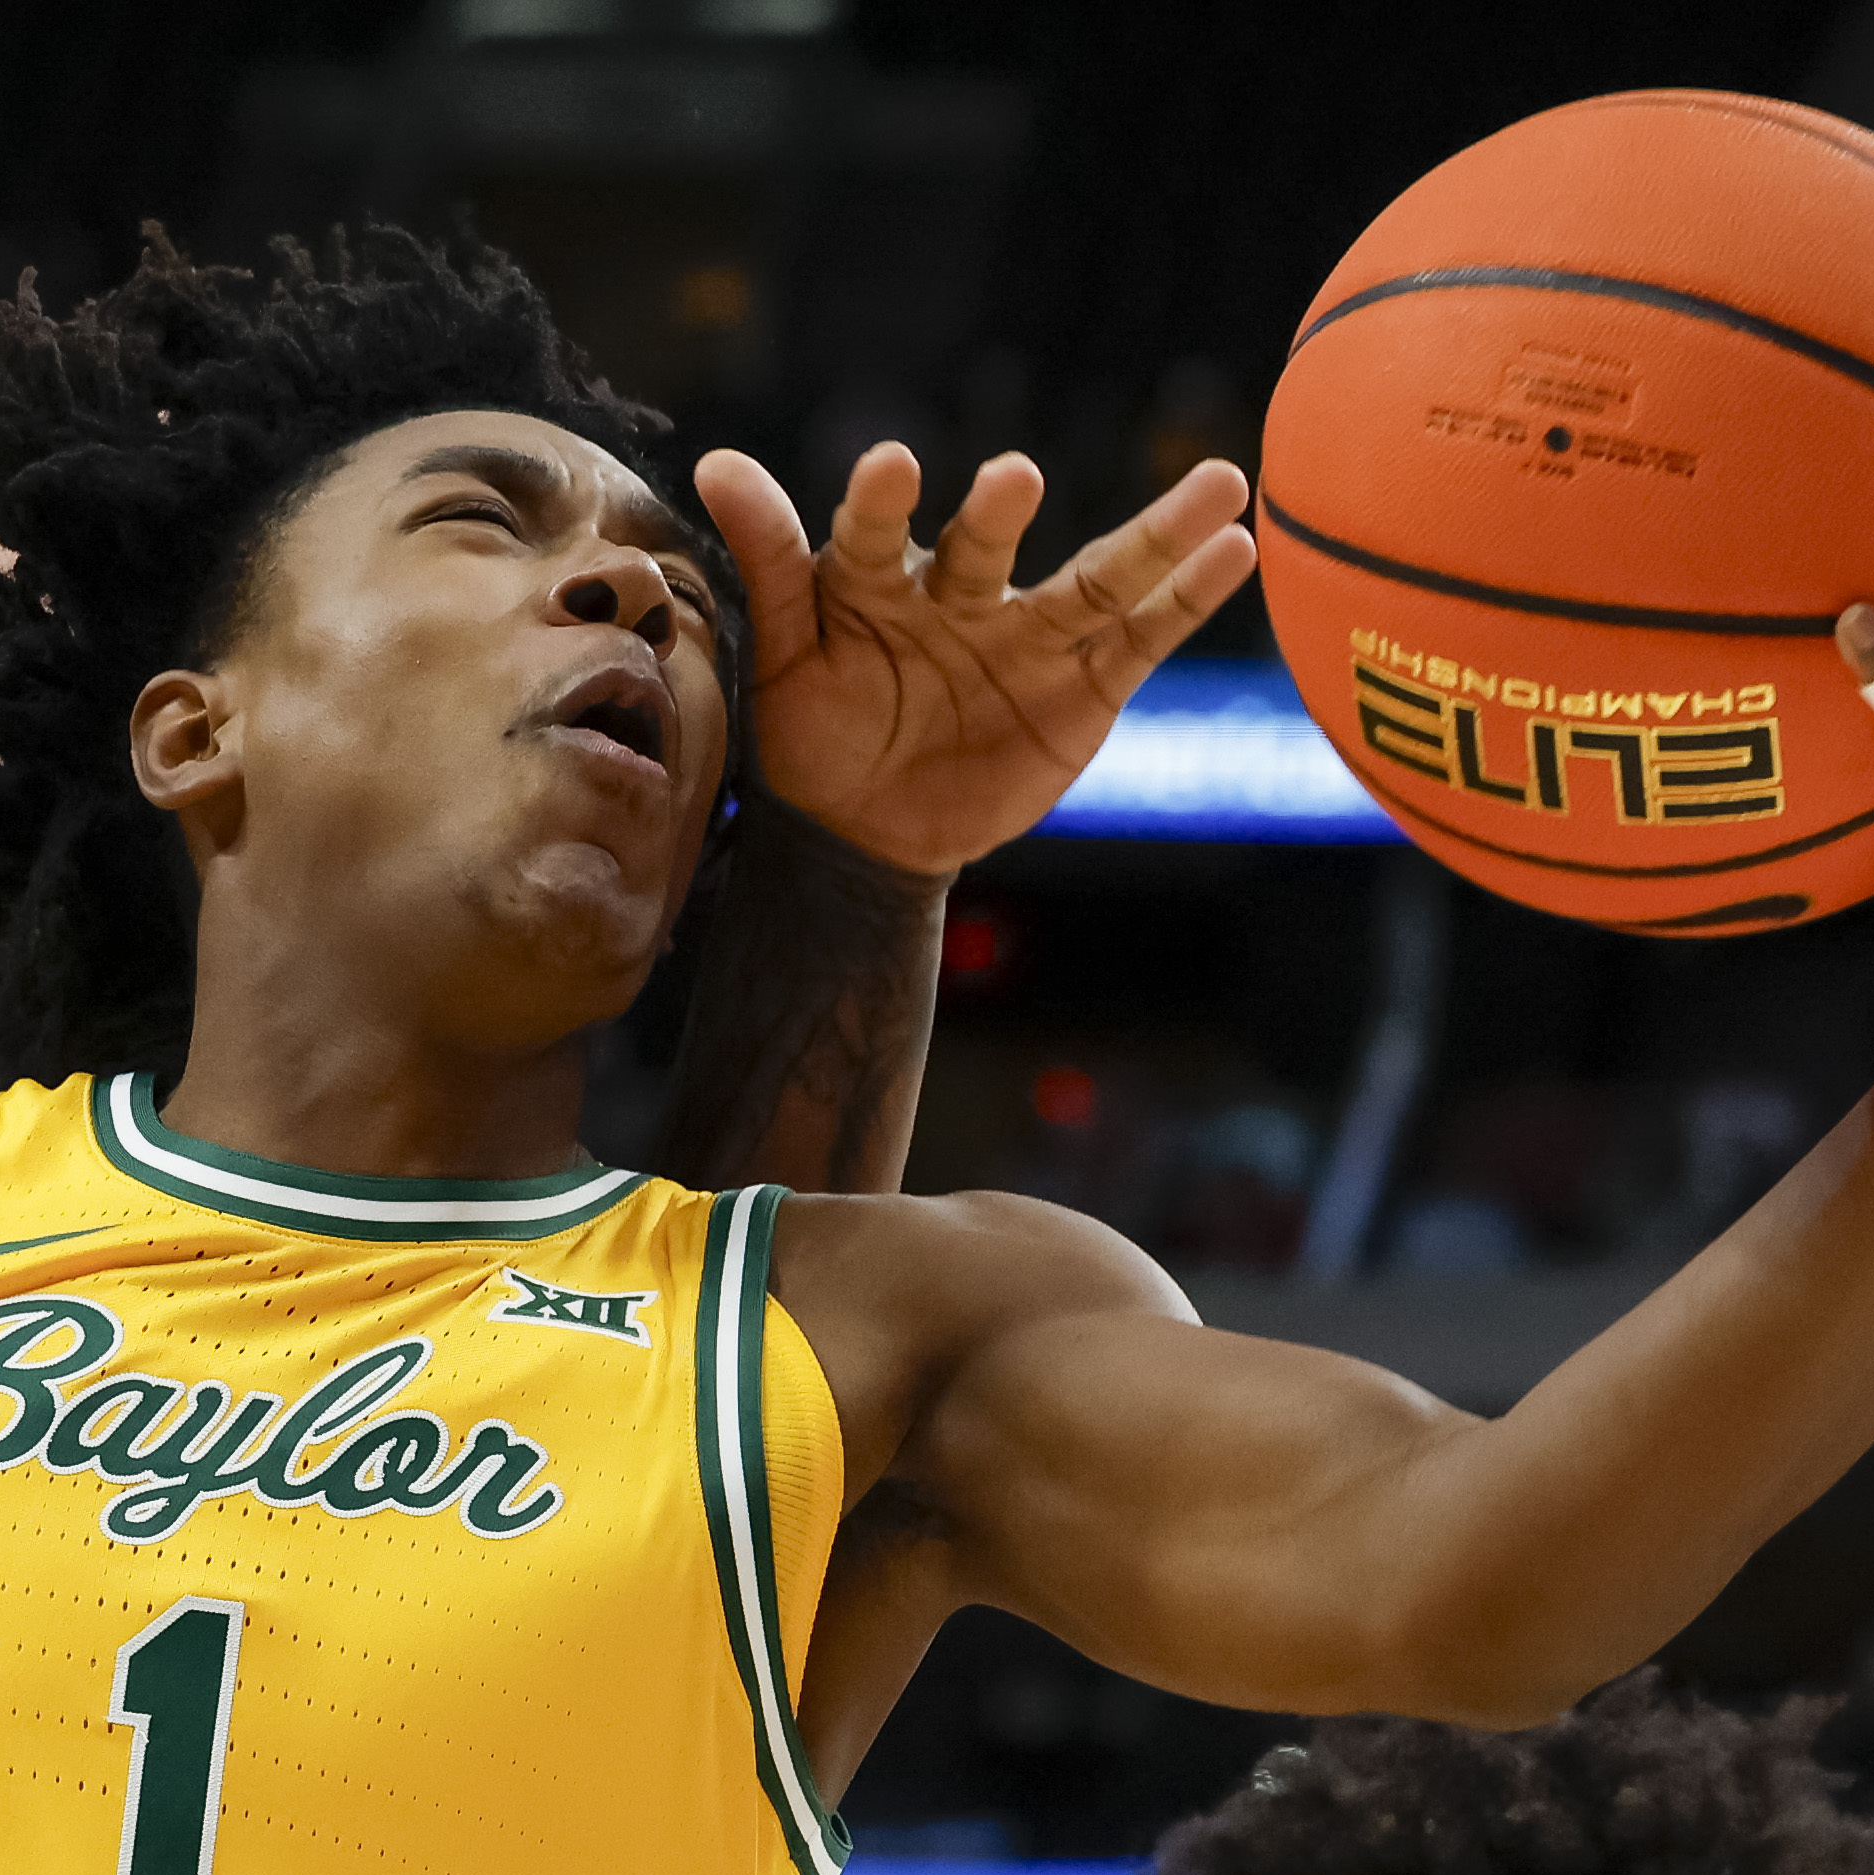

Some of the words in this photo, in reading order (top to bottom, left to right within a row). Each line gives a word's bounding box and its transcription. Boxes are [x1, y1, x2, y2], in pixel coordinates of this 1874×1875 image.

[1349, 626, 1778, 721] CHAMPIONSHIP
[1350, 653, 1786, 827] ELITE
[488, 1267, 657, 1347] XII
